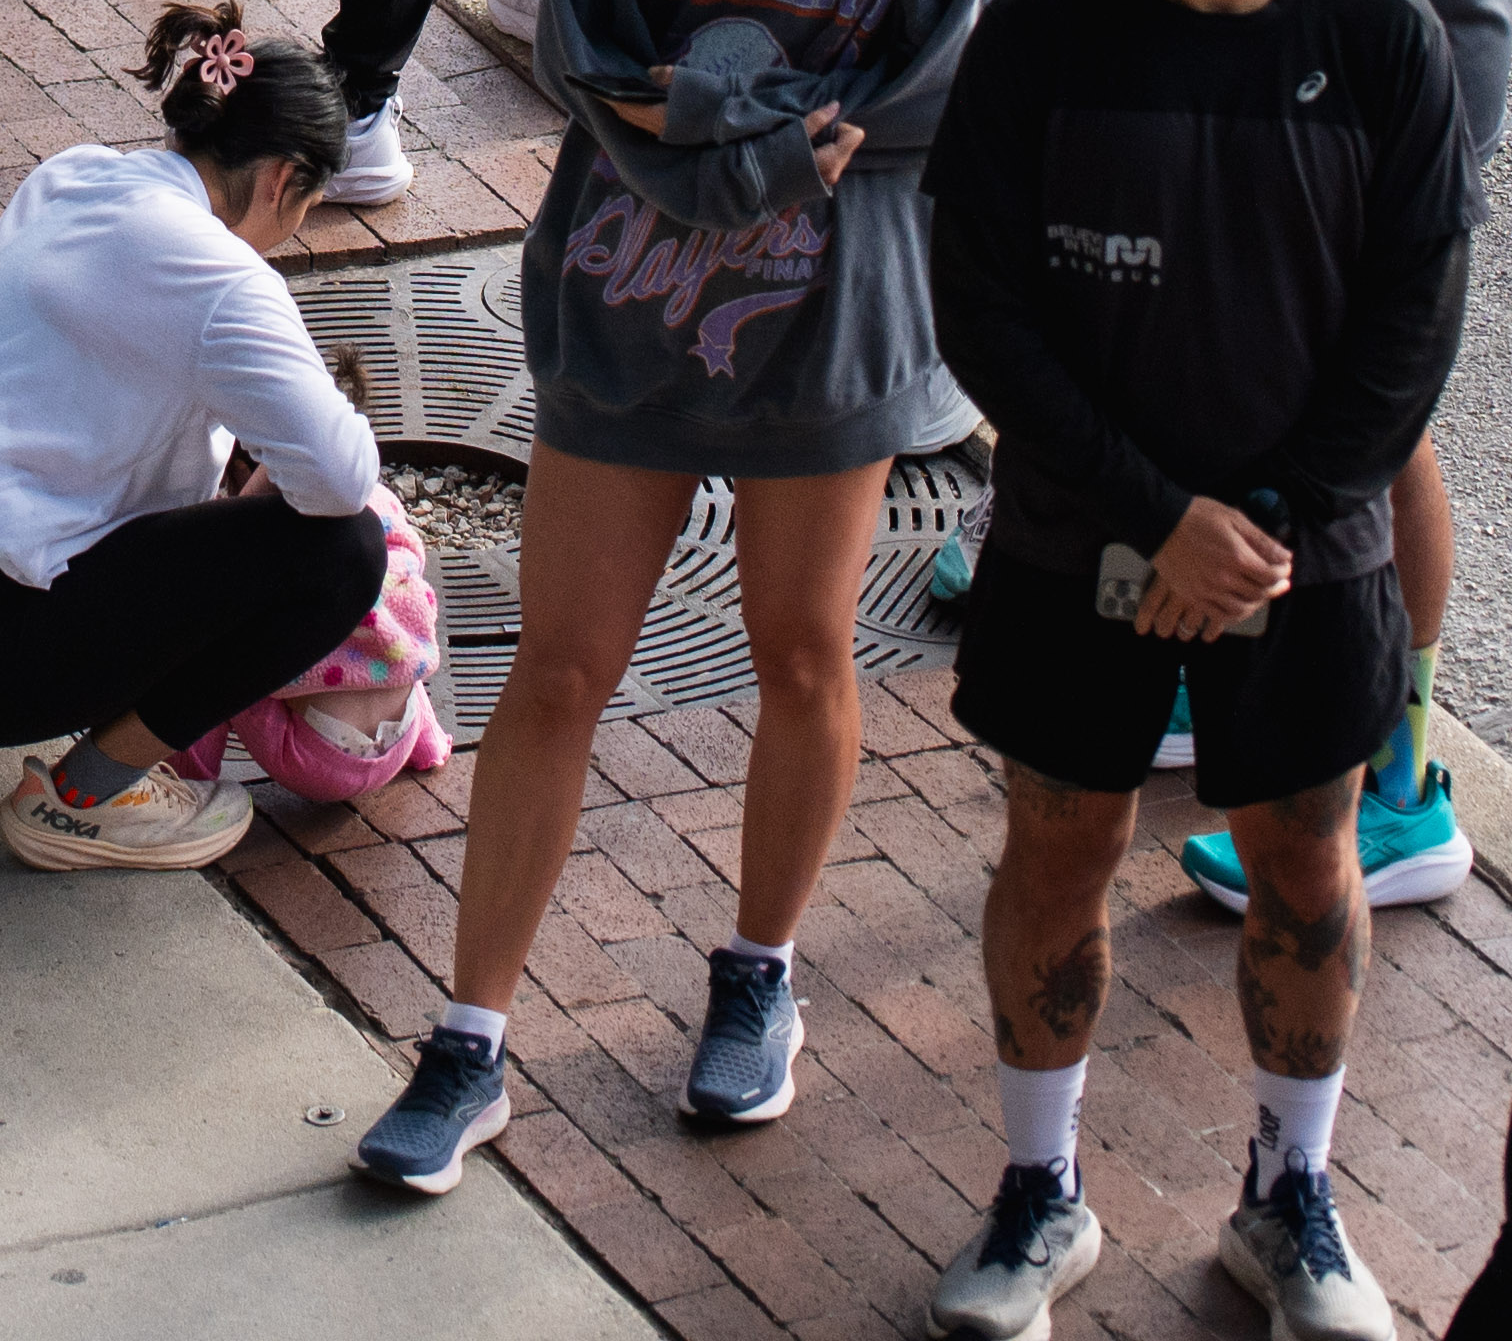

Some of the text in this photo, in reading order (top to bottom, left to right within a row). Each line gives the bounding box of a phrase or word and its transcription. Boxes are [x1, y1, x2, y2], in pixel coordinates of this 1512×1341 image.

[745, 257, 823, 281] FINA
[30, 801, 101, 839] HOKA
[1257, 1103, 1282, 1152] LOOP
